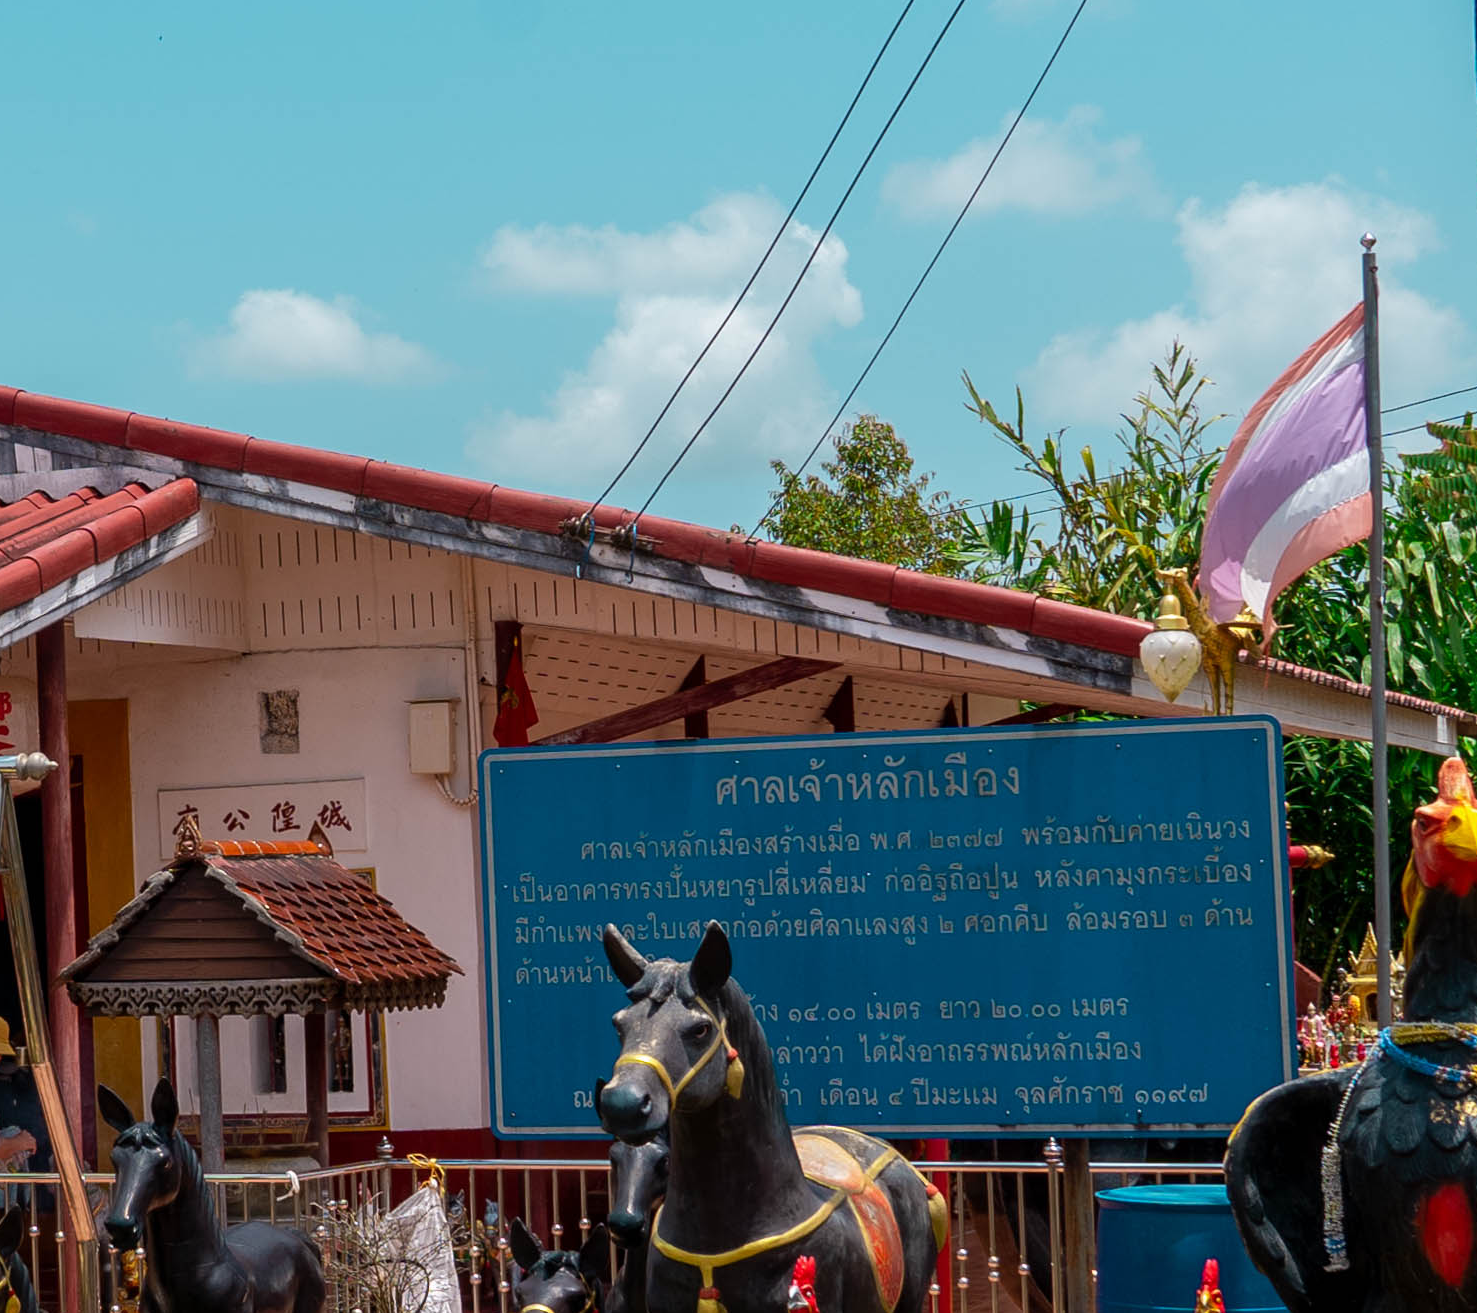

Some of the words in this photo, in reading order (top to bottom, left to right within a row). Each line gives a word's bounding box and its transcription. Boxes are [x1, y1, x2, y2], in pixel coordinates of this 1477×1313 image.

[716, 751, 1020, 805] ศาลเจ้าหลักเมือง
[581, 818, 860, 861] ศาลเจ้าหลักเมืองสร้างเมื่อ
[929, 827, 1003, 849] ๒๓๗๗
[1021, 812, 1250, 847] พร้อมกับค่ายเนินวง
[513, 860, 867, 907] เป็นอาคารทรงปั้นหยารูปสี่เหลี่ยม
[884, 862, 1019, 901] ก่ออิฐถือปูน
[1034, 845, 1252, 896] หลังคามุงกระเบื้อง
[515, 907, 928, 945] มีกำแพงละใบเสาก่อด้วยศิลาแลงสูง
[939, 914, 953, 934] ๒
[964, 904, 1048, 934] ศอกคืบ
[1066, 902, 1167, 931] ล้อมรอบ
[1178, 913, 1194, 927] ๓
[1204, 898, 1253, 927] ด้าน
[866, 998, 921, 1021] เมตร
[939, 999, 980, 1020] ยาว
[991, 997, 1061, 1019] ๒๐.๐๐
[1072, 994, 1130, 1017] เมตร
[771, 1035, 844, 1065] ล่าวว่า
[859, 1031, 1142, 1065] ได้ฝังอาถรรพณ์หลักเมือง
[573, 1088, 594, 1109] ณ
[820, 1079, 878, 1106] เดือน
[912, 1079, 997, 1106] ปีมะแม
[1014, 1076, 1124, 1115] จุลศักราช
[1135, 1082, 1209, 1104] ๑๑๙๗
